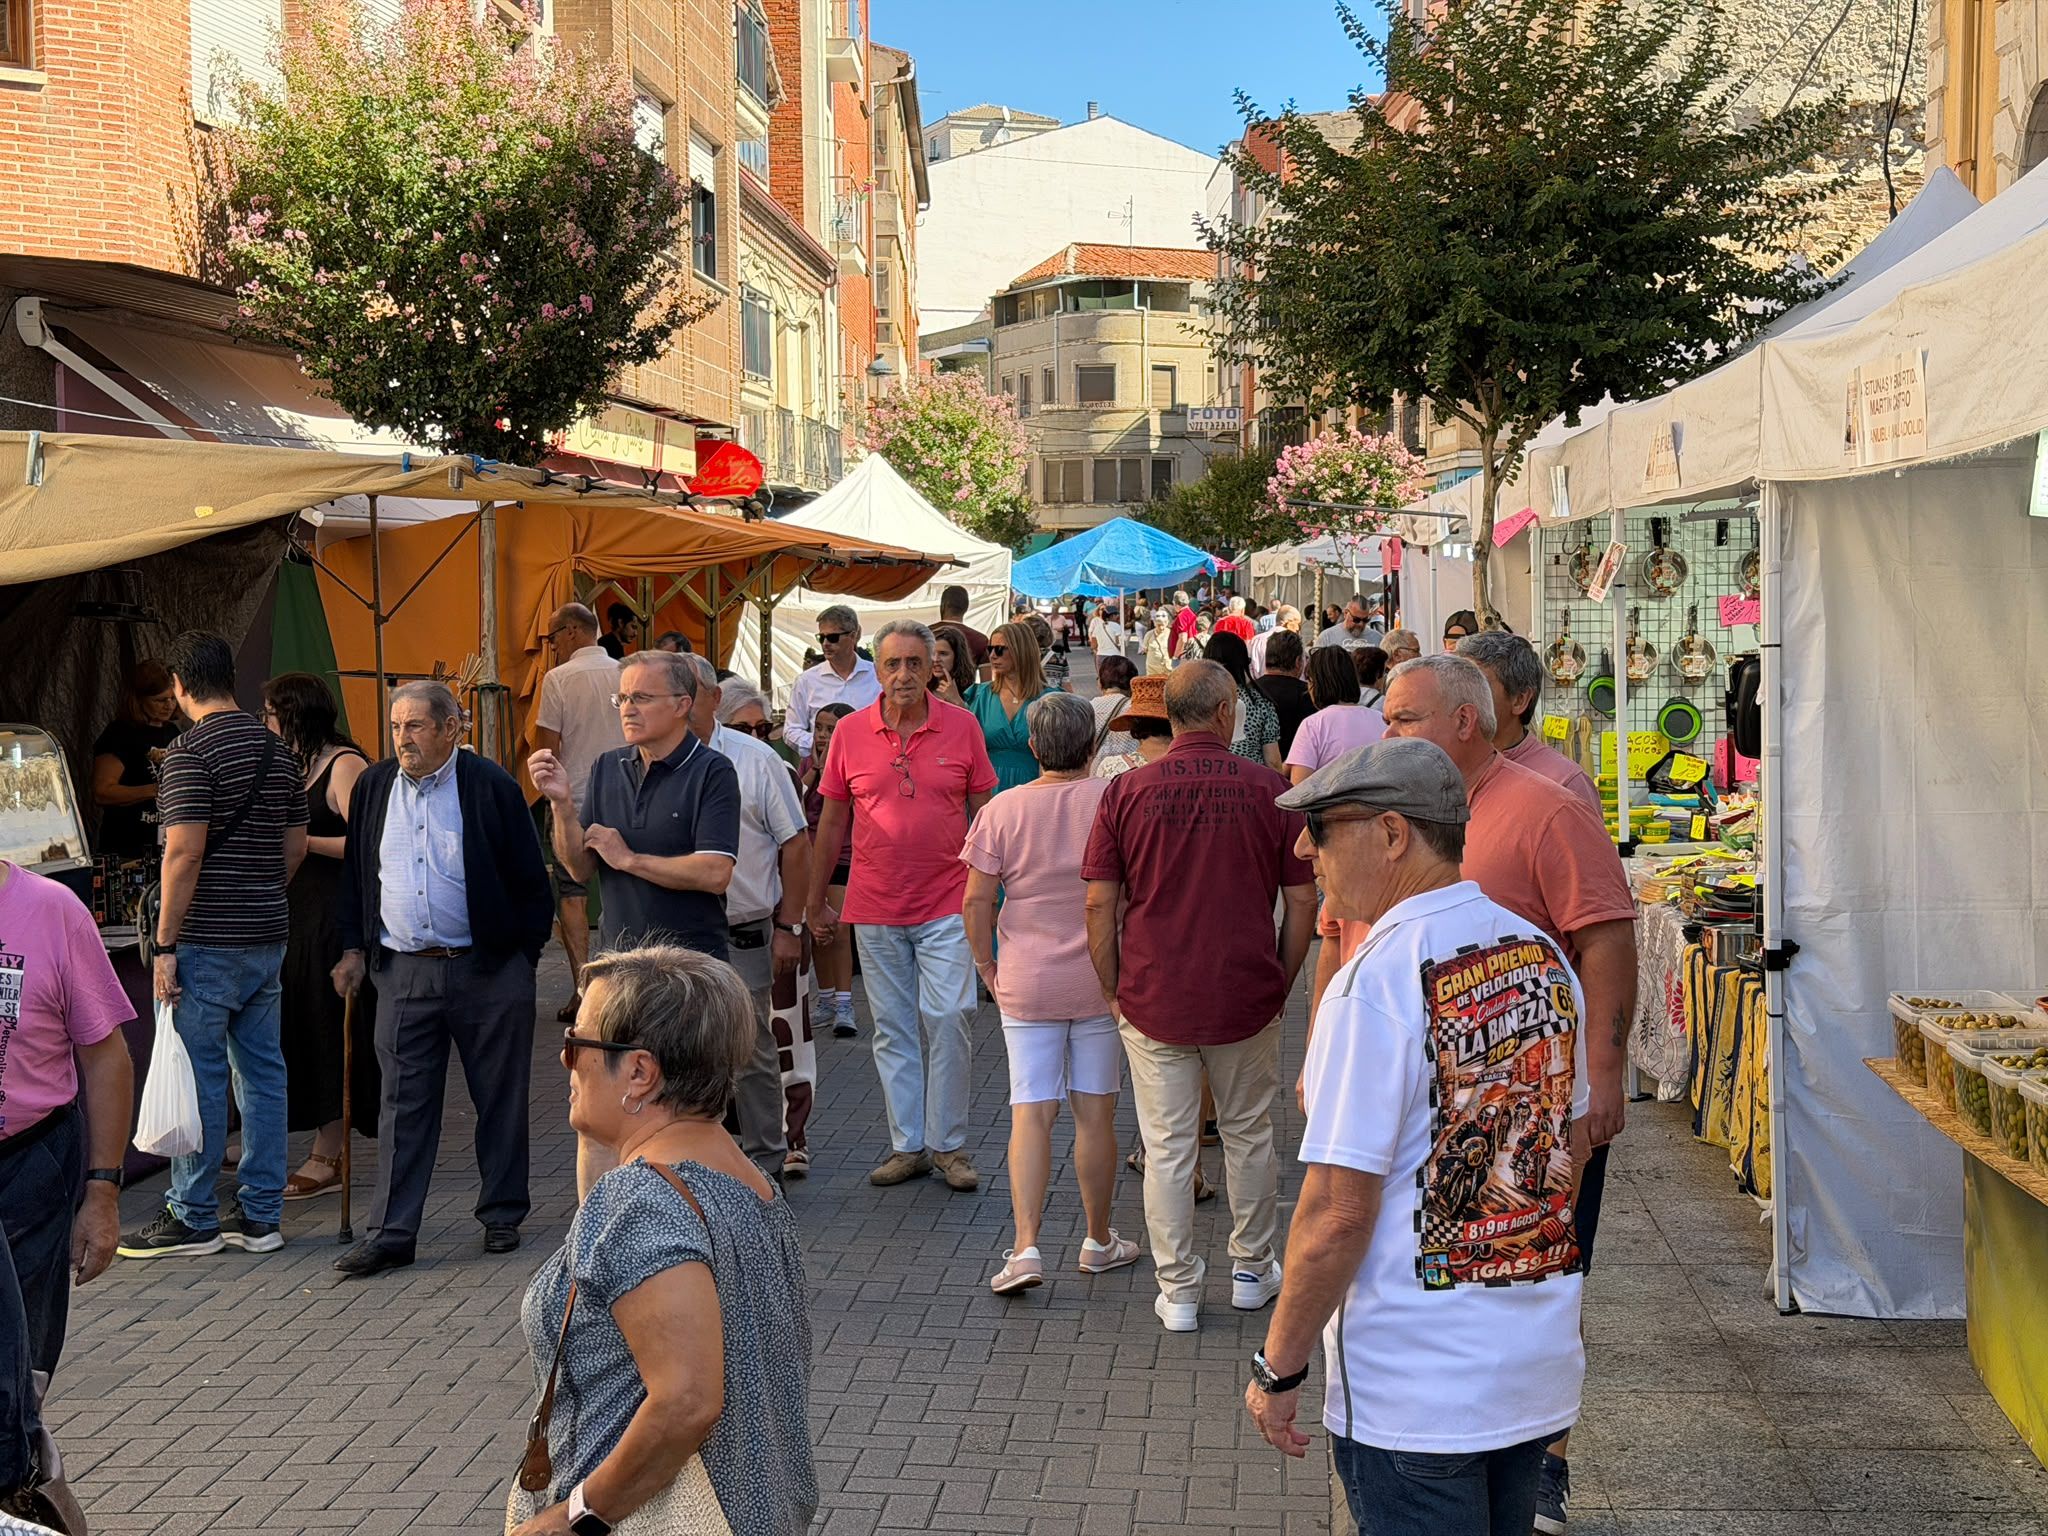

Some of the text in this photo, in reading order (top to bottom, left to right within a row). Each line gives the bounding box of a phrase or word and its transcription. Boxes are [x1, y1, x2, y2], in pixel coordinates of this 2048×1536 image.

[1190, 408, 1237, 420] FOTO
[1435, 944, 1545, 1004] GRAN PREMIO
[1456, 993, 1471, 1009] DE
[1470, 963, 1540, 1003] VELOCIDAD
[1507, 992, 1521, 1008] de
[1457, 1030, 1486, 1065] LA
[1487, 1036, 1520, 1066] 202
[1468, 1223, 1478, 1240] 8
[1486, 1220, 1496, 1237] 9
[1496, 1219, 1509, 1233] DE
